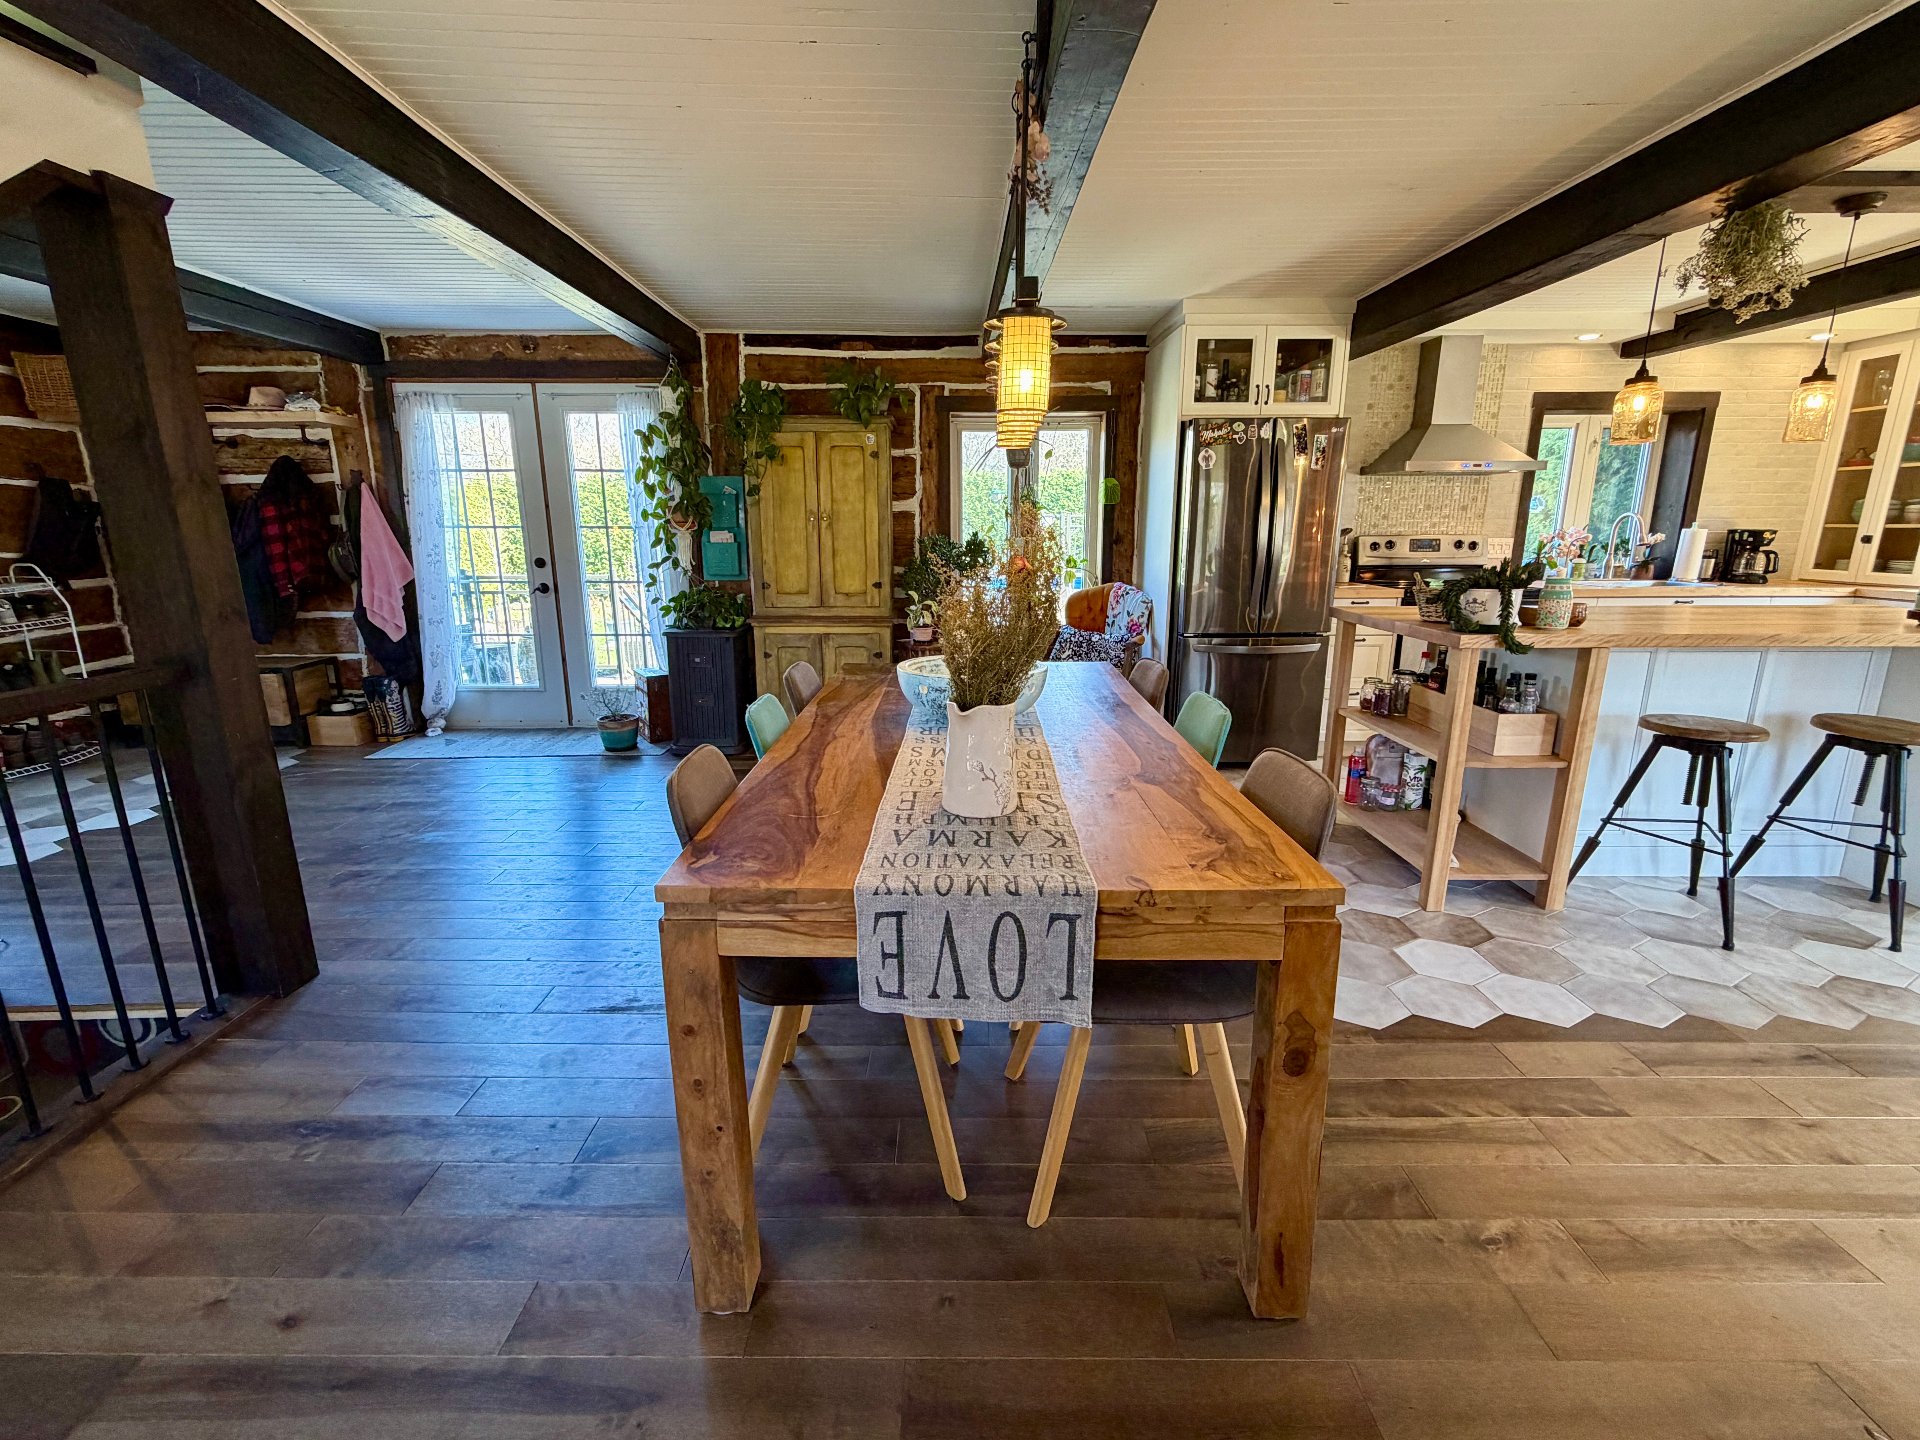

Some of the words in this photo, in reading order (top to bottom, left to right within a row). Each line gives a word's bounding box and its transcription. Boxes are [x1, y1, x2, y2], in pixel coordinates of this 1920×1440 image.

[892, 829, 1073, 848] KARMA
[880, 852, 1075, 869] RELAXATION
[872, 873, 1083, 898] HARMONY
[872, 910, 1082, 1003] LOVE
